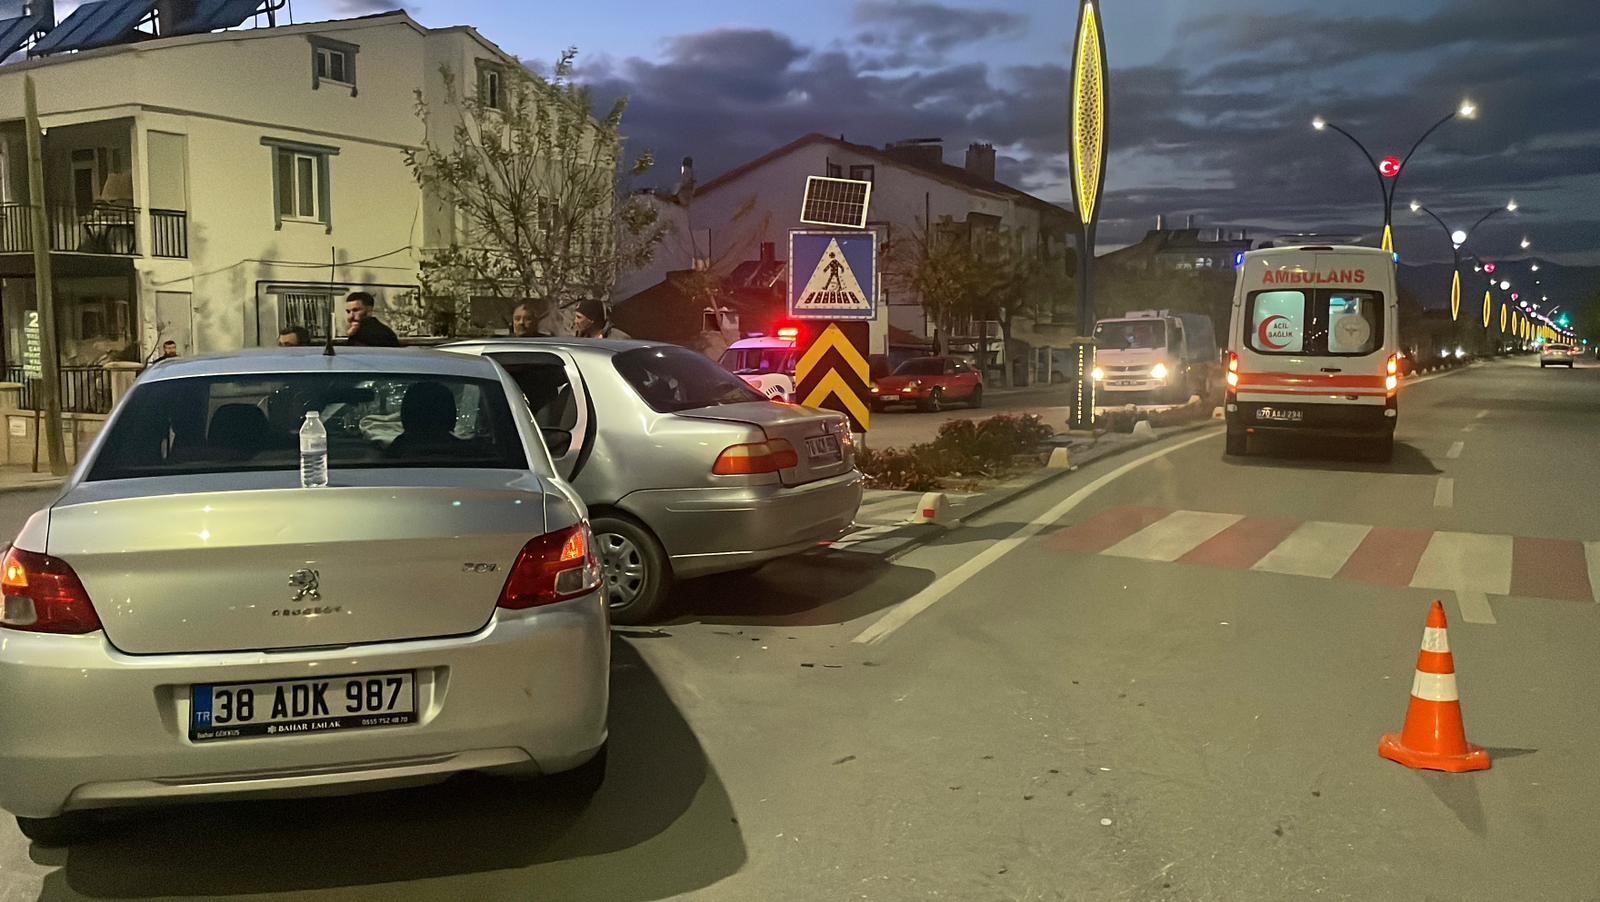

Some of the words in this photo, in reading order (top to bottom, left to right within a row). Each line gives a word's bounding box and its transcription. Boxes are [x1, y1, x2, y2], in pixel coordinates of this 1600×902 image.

[1263, 270, 1366, 284] AMBULANS
[214, 688, 254, 723] 38
[271, 682, 330, 719] ADK
[345, 678, 403, 713] 987
[196, 711, 210, 721] TR
[278, 723, 308, 733] BAHAR
[312, 721, 341, 731] EMLAK
